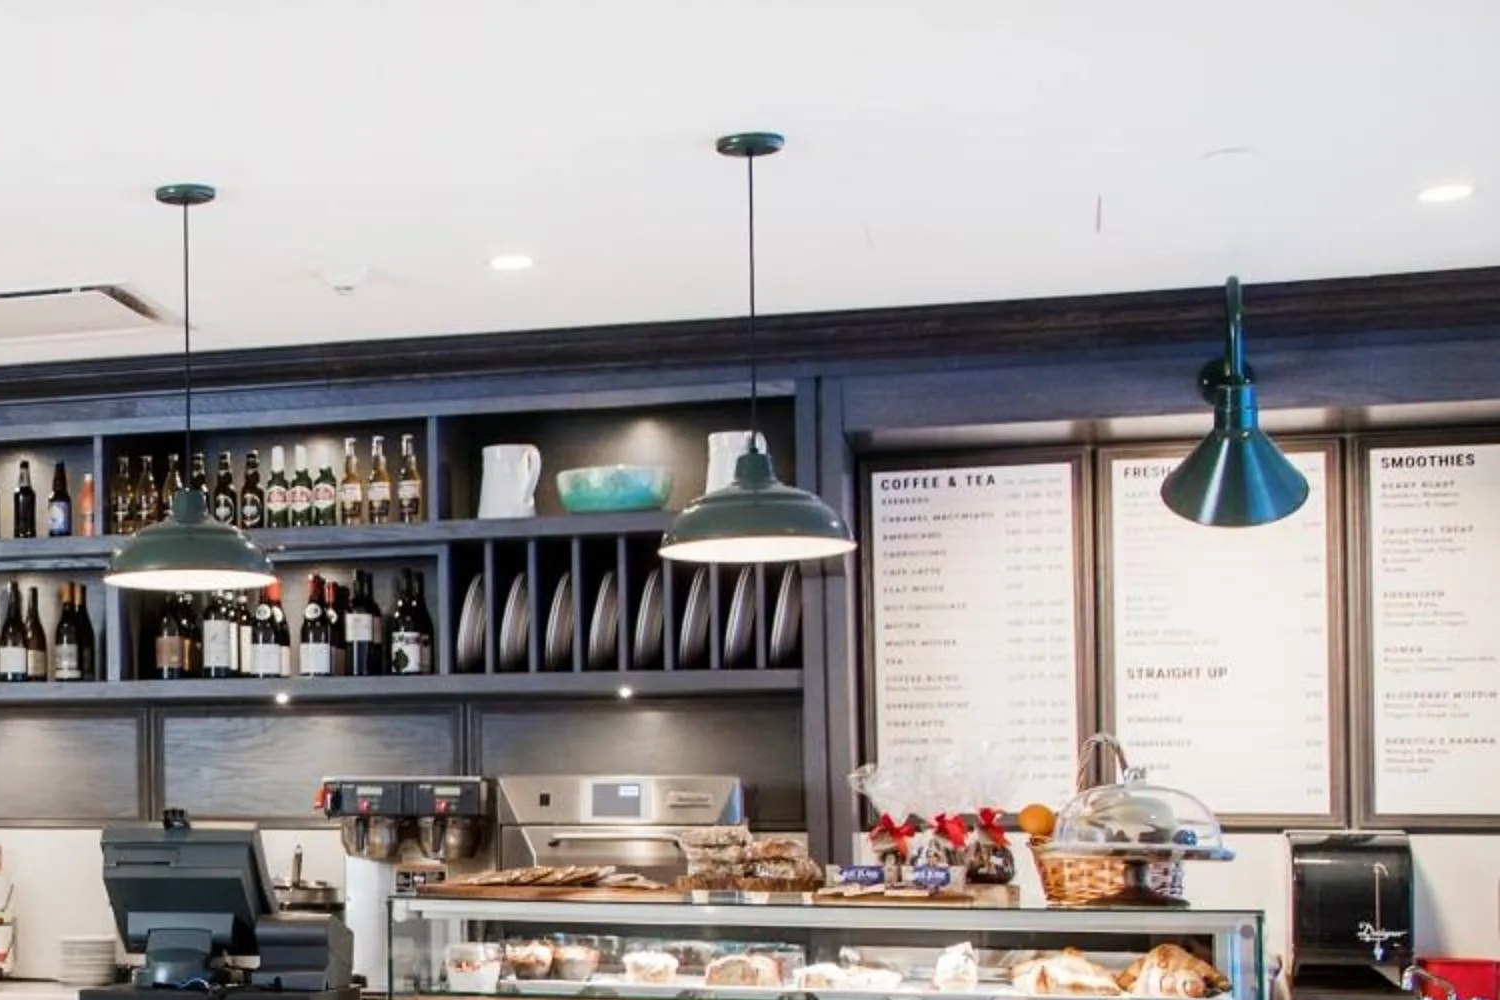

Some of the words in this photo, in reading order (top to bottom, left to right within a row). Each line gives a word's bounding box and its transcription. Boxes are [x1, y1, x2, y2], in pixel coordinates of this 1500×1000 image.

[1380, 453, 1476, 469] SMOOTHIES
[881, 476, 939, 491] COFFEE
[948, 475, 957, 488] &
[966, 474, 996, 487] TEA
[1126, 667, 1201, 680] STRAIGHT
[1207, 666, 1228, 679] UP
